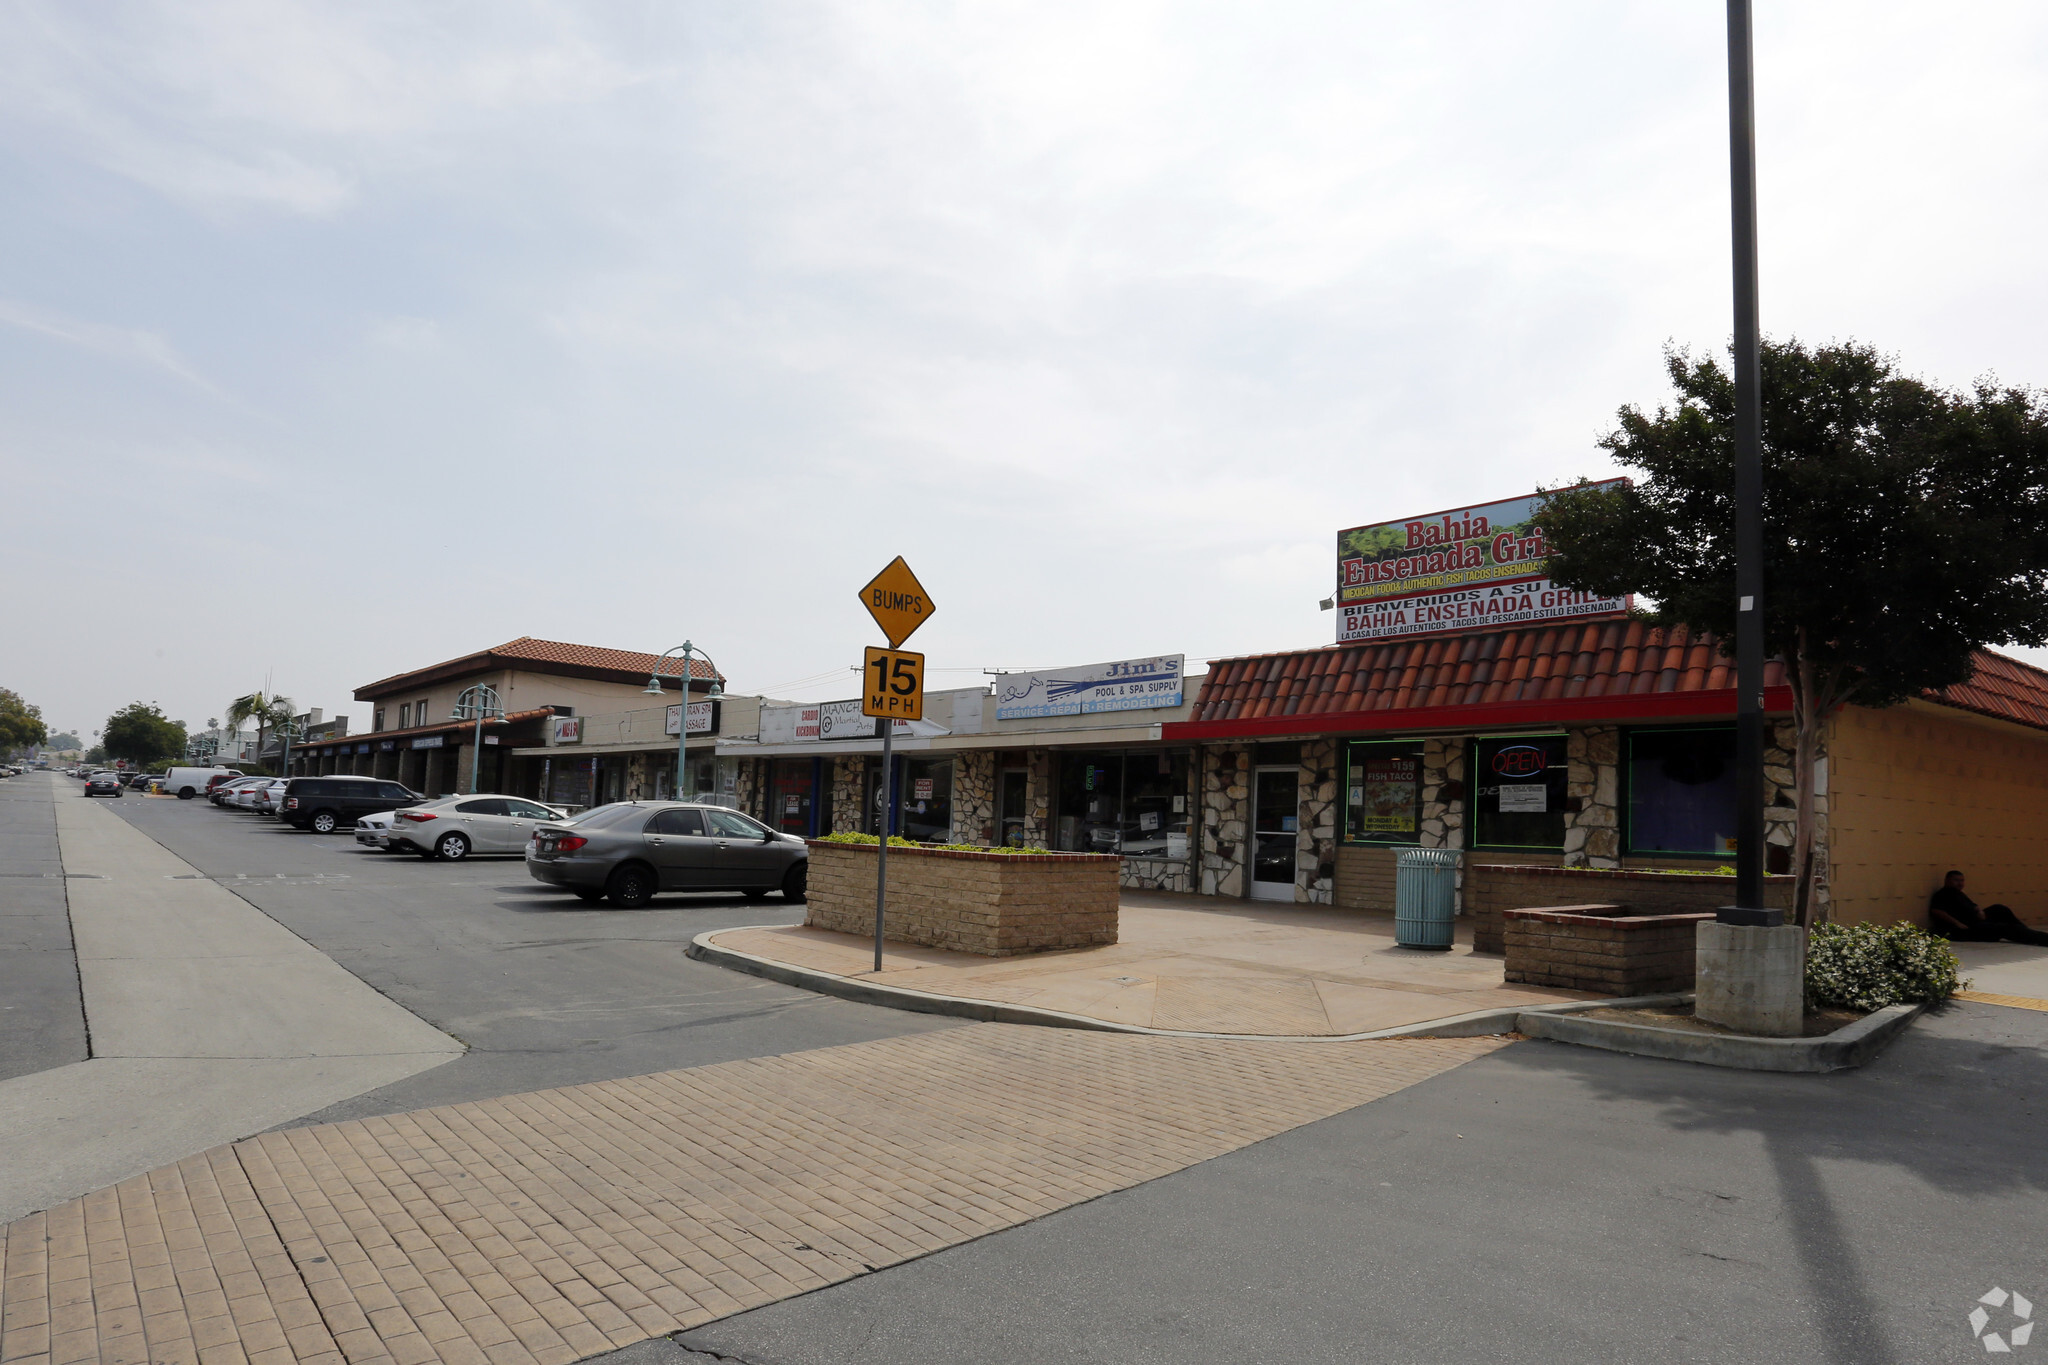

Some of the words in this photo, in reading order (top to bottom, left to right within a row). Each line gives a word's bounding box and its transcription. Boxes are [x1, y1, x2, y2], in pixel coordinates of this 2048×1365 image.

[1404, 511, 1492, 552] Bahia
[1341, 543, 1485, 589] Ensenada
[1342, 584, 1375, 600] MEXICAN
[1402, 574, 1444, 591] AUTHENTIC
[1446, 571, 1463, 584] FISH
[1464, 568, 1491, 582] TACOS
[1492, 561, 1538, 578] ENSENADA
[873, 589, 922, 614] BUMPS
[1344, 590, 1481, 617] BIENVENIDOS
[1489, 587, 1508, 598] A
[1511, 582, 1541, 595] SU
[1341, 631, 1350, 640] LA
[1350, 629, 1371, 639] CASA
[1372, 628, 1382, 637] DE
[1383, 626, 1397, 636] LOS
[1398, 621, 1446, 634] AUTENTICOS
[1451, 618, 1476, 628] TACOS
[1478, 616, 1490, 626] DE
[1492, 612, 1532, 624] PESCADO
[1533, 609, 1565, 620] ESTILO
[1566, 601, 1618, 617] ENSENADA
[1346, 611, 1406, 632] BAHIA
[1414, 596, 1532, 622] ENSENADA
[871, 656, 916, 696] 15
[1106, 659, 1178, 677] Jim's
[1095, 687, 1116, 697] POOL
[1129, 684, 1144, 694] SPA
[1148, 681, 1177, 692] SUPPLY
[822, 703, 864, 717] MANCH
[872, 695, 914, 713] MPH
[1000, 708, 1044, 718] SERVICE
[1050, 703, 1090, 715] REPAIR
[1096, 696, 1175, 711] REMODELING
[833, 714, 860, 726] Martial
[855, 722, 874, 732] Arts
[1492, 750, 1548, 772] OPEN
[1368, 772, 1388, 780] FISH
[1390, 772, 1414, 780] TACO
[1352, 790, 1360, 798] A
